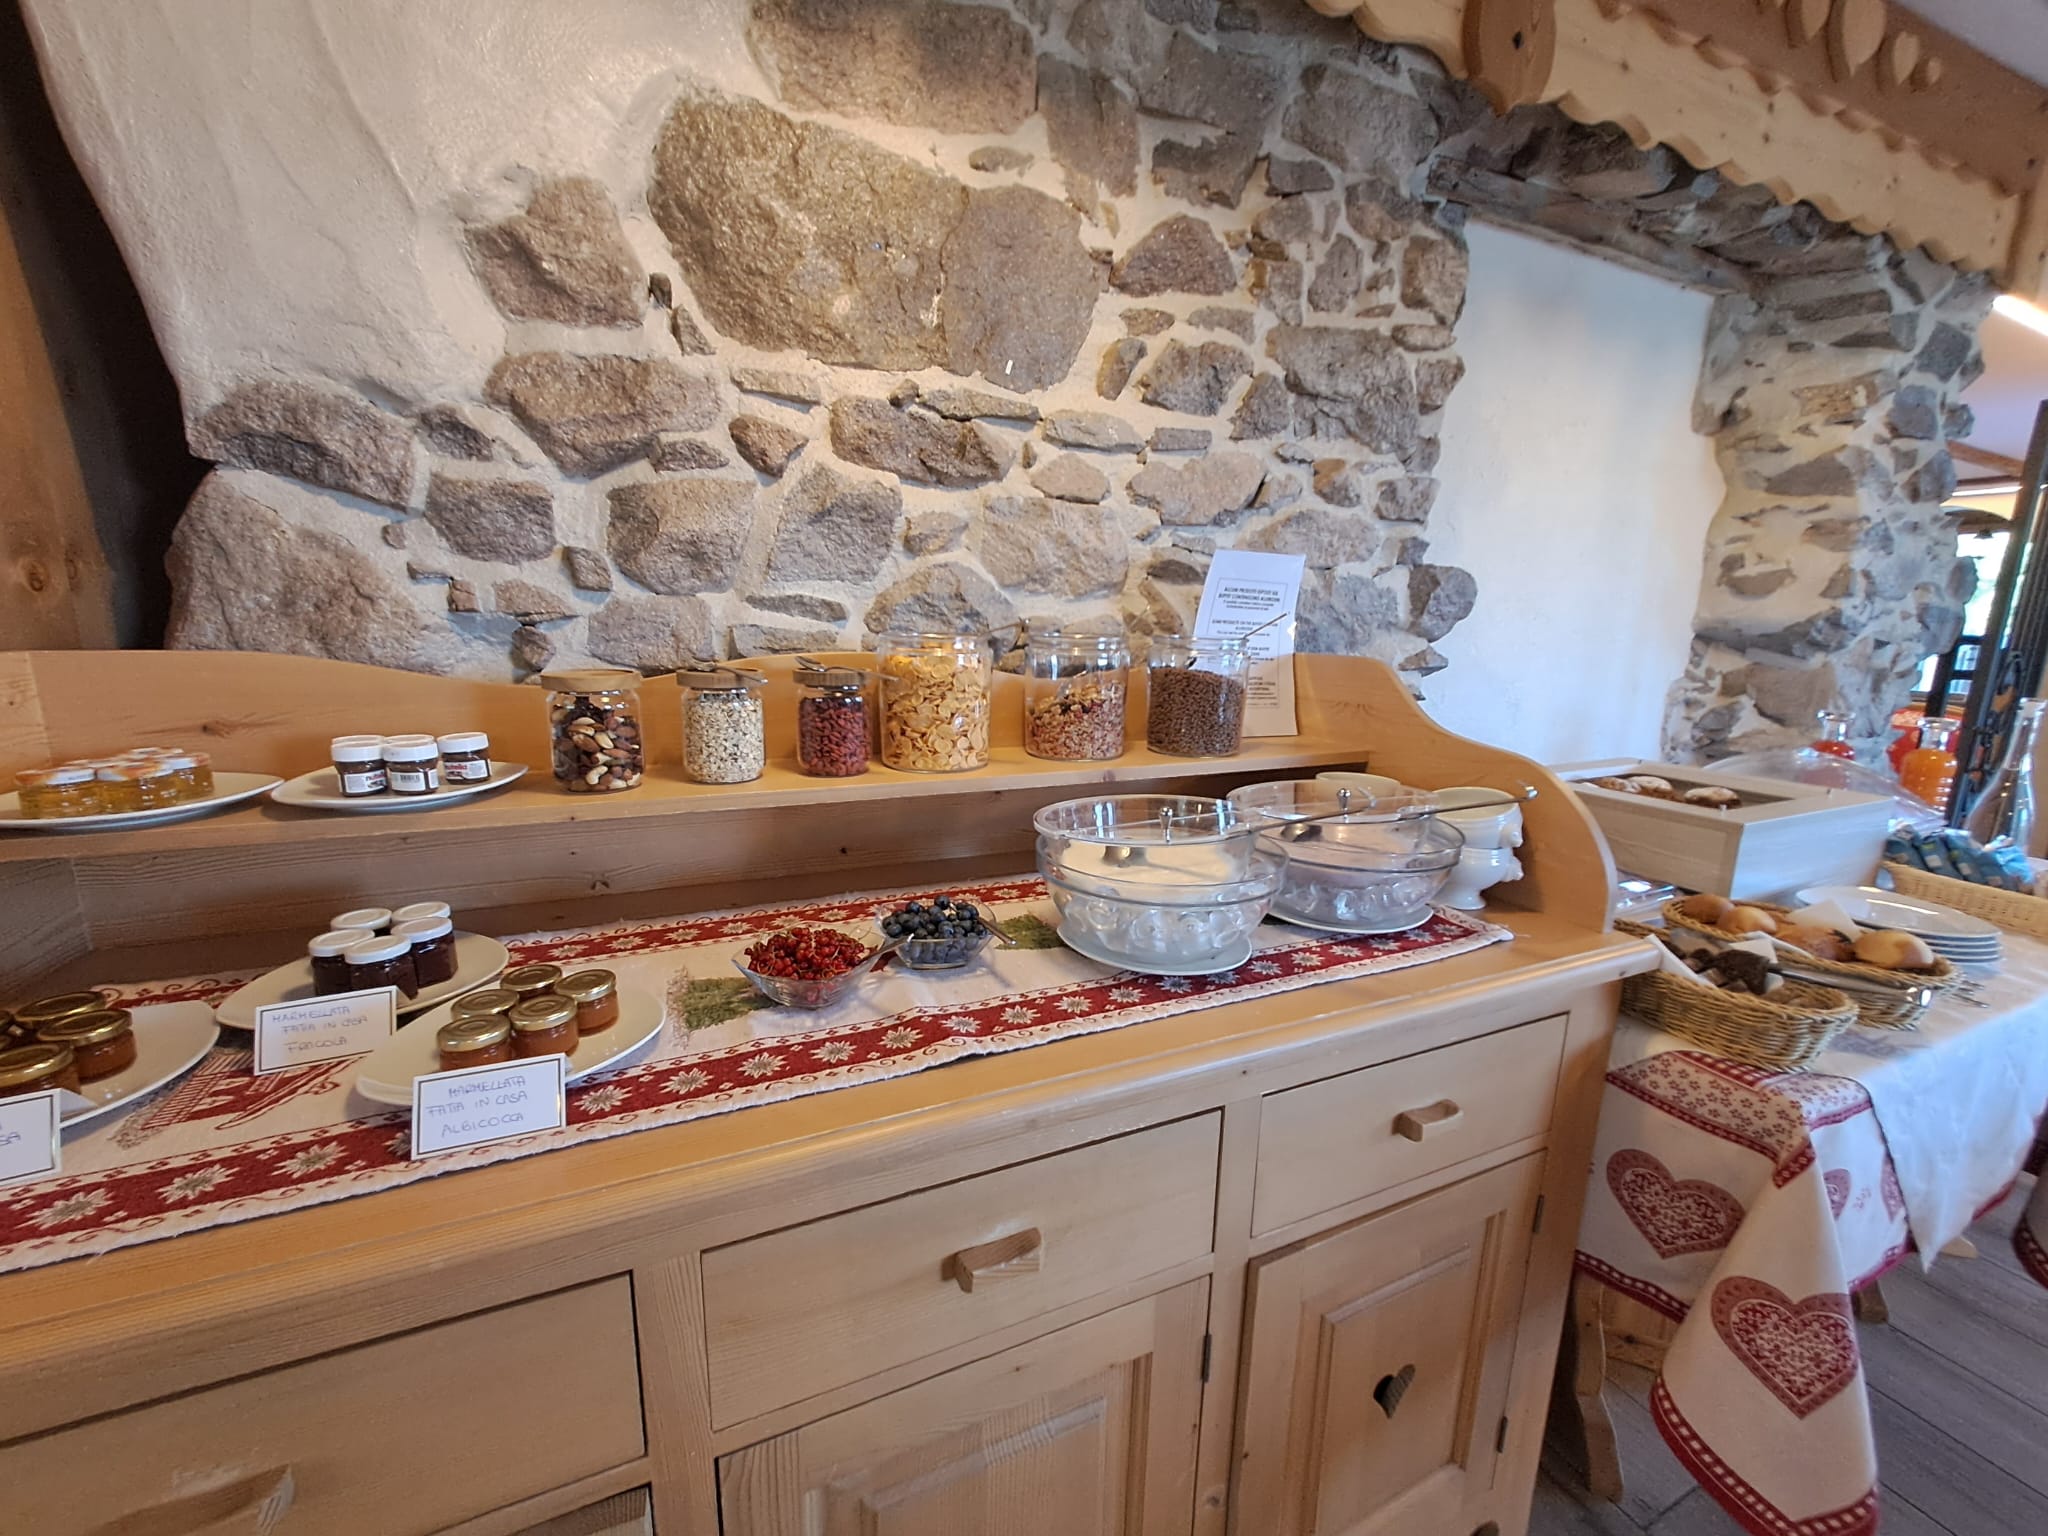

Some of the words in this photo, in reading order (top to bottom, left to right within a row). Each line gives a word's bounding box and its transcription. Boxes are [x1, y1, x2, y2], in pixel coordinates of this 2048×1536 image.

[272, 1006, 350, 1022] MARMELLATA
[323, 1021, 337, 1029] IN
[448, 1075, 526, 1098] MARMELLATA
[475, 1096, 490, 1108] IN
[495, 1090, 528, 1105] CASA
[441, 1112, 524, 1138] ALBICOCCA
